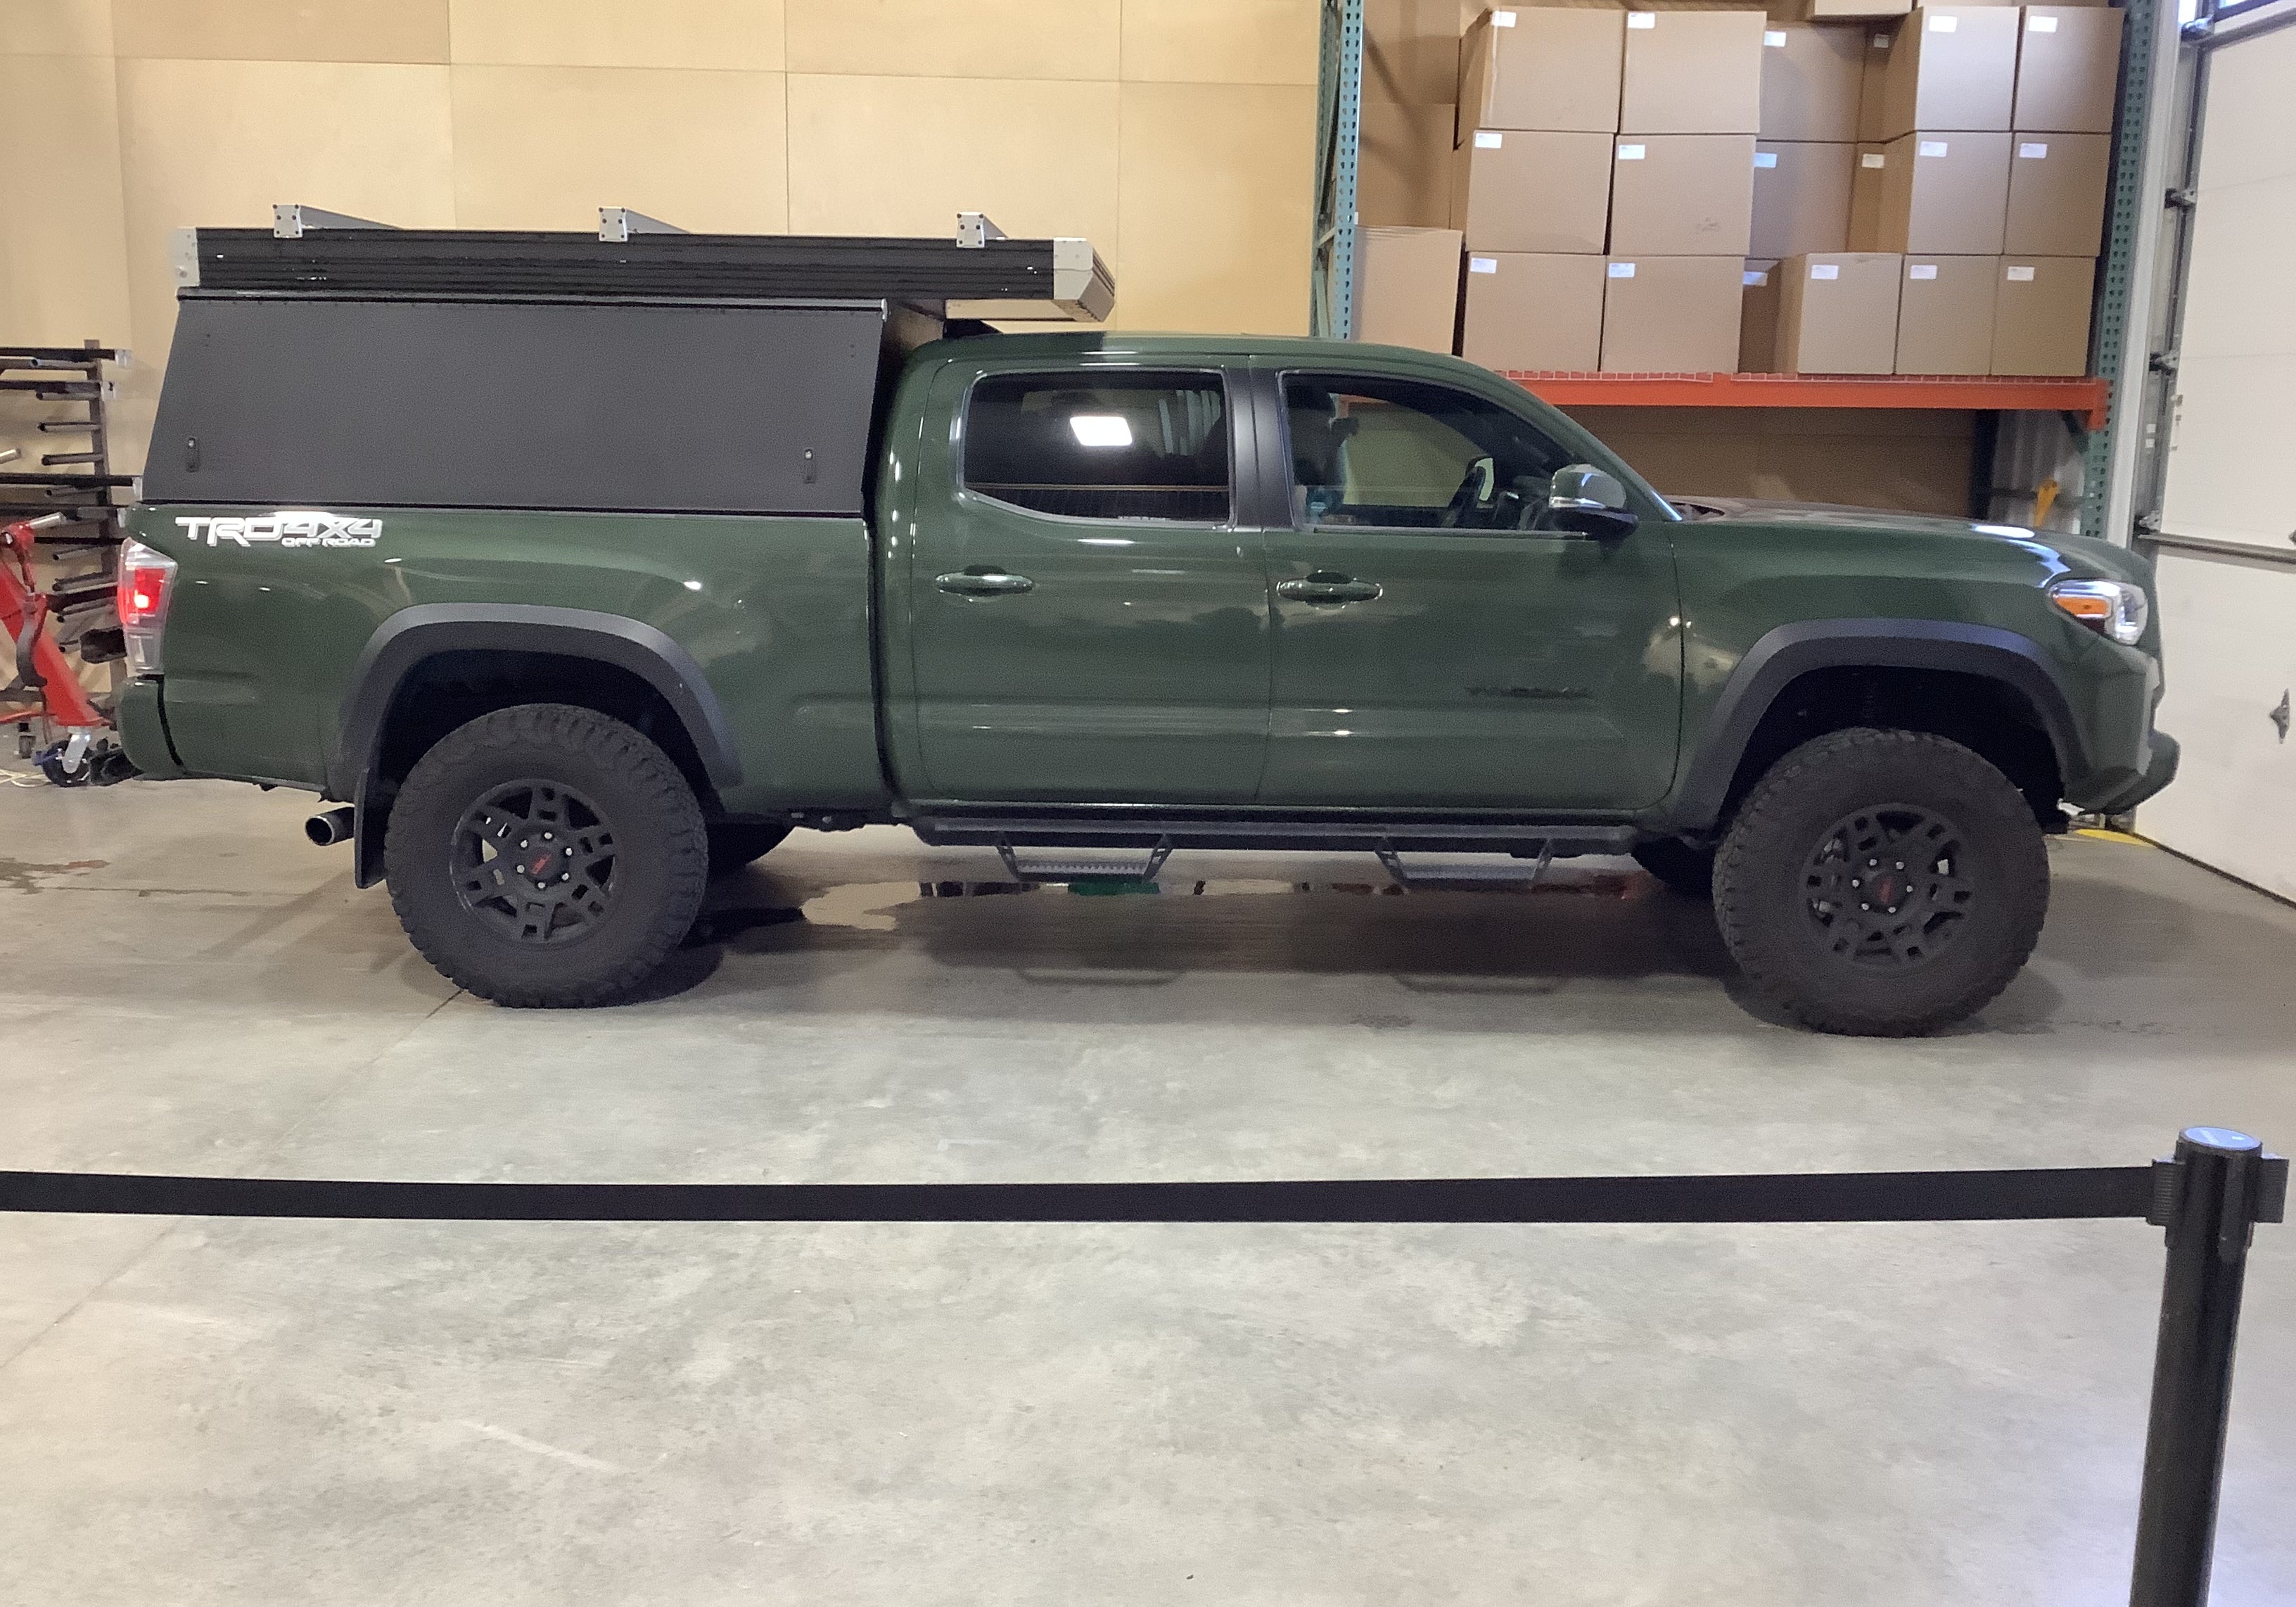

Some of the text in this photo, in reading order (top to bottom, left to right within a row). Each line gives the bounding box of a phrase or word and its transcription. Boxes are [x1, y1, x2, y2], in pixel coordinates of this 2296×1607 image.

[175, 516, 282, 547] TRD
[281, 537, 376, 547] OFF ROAD
